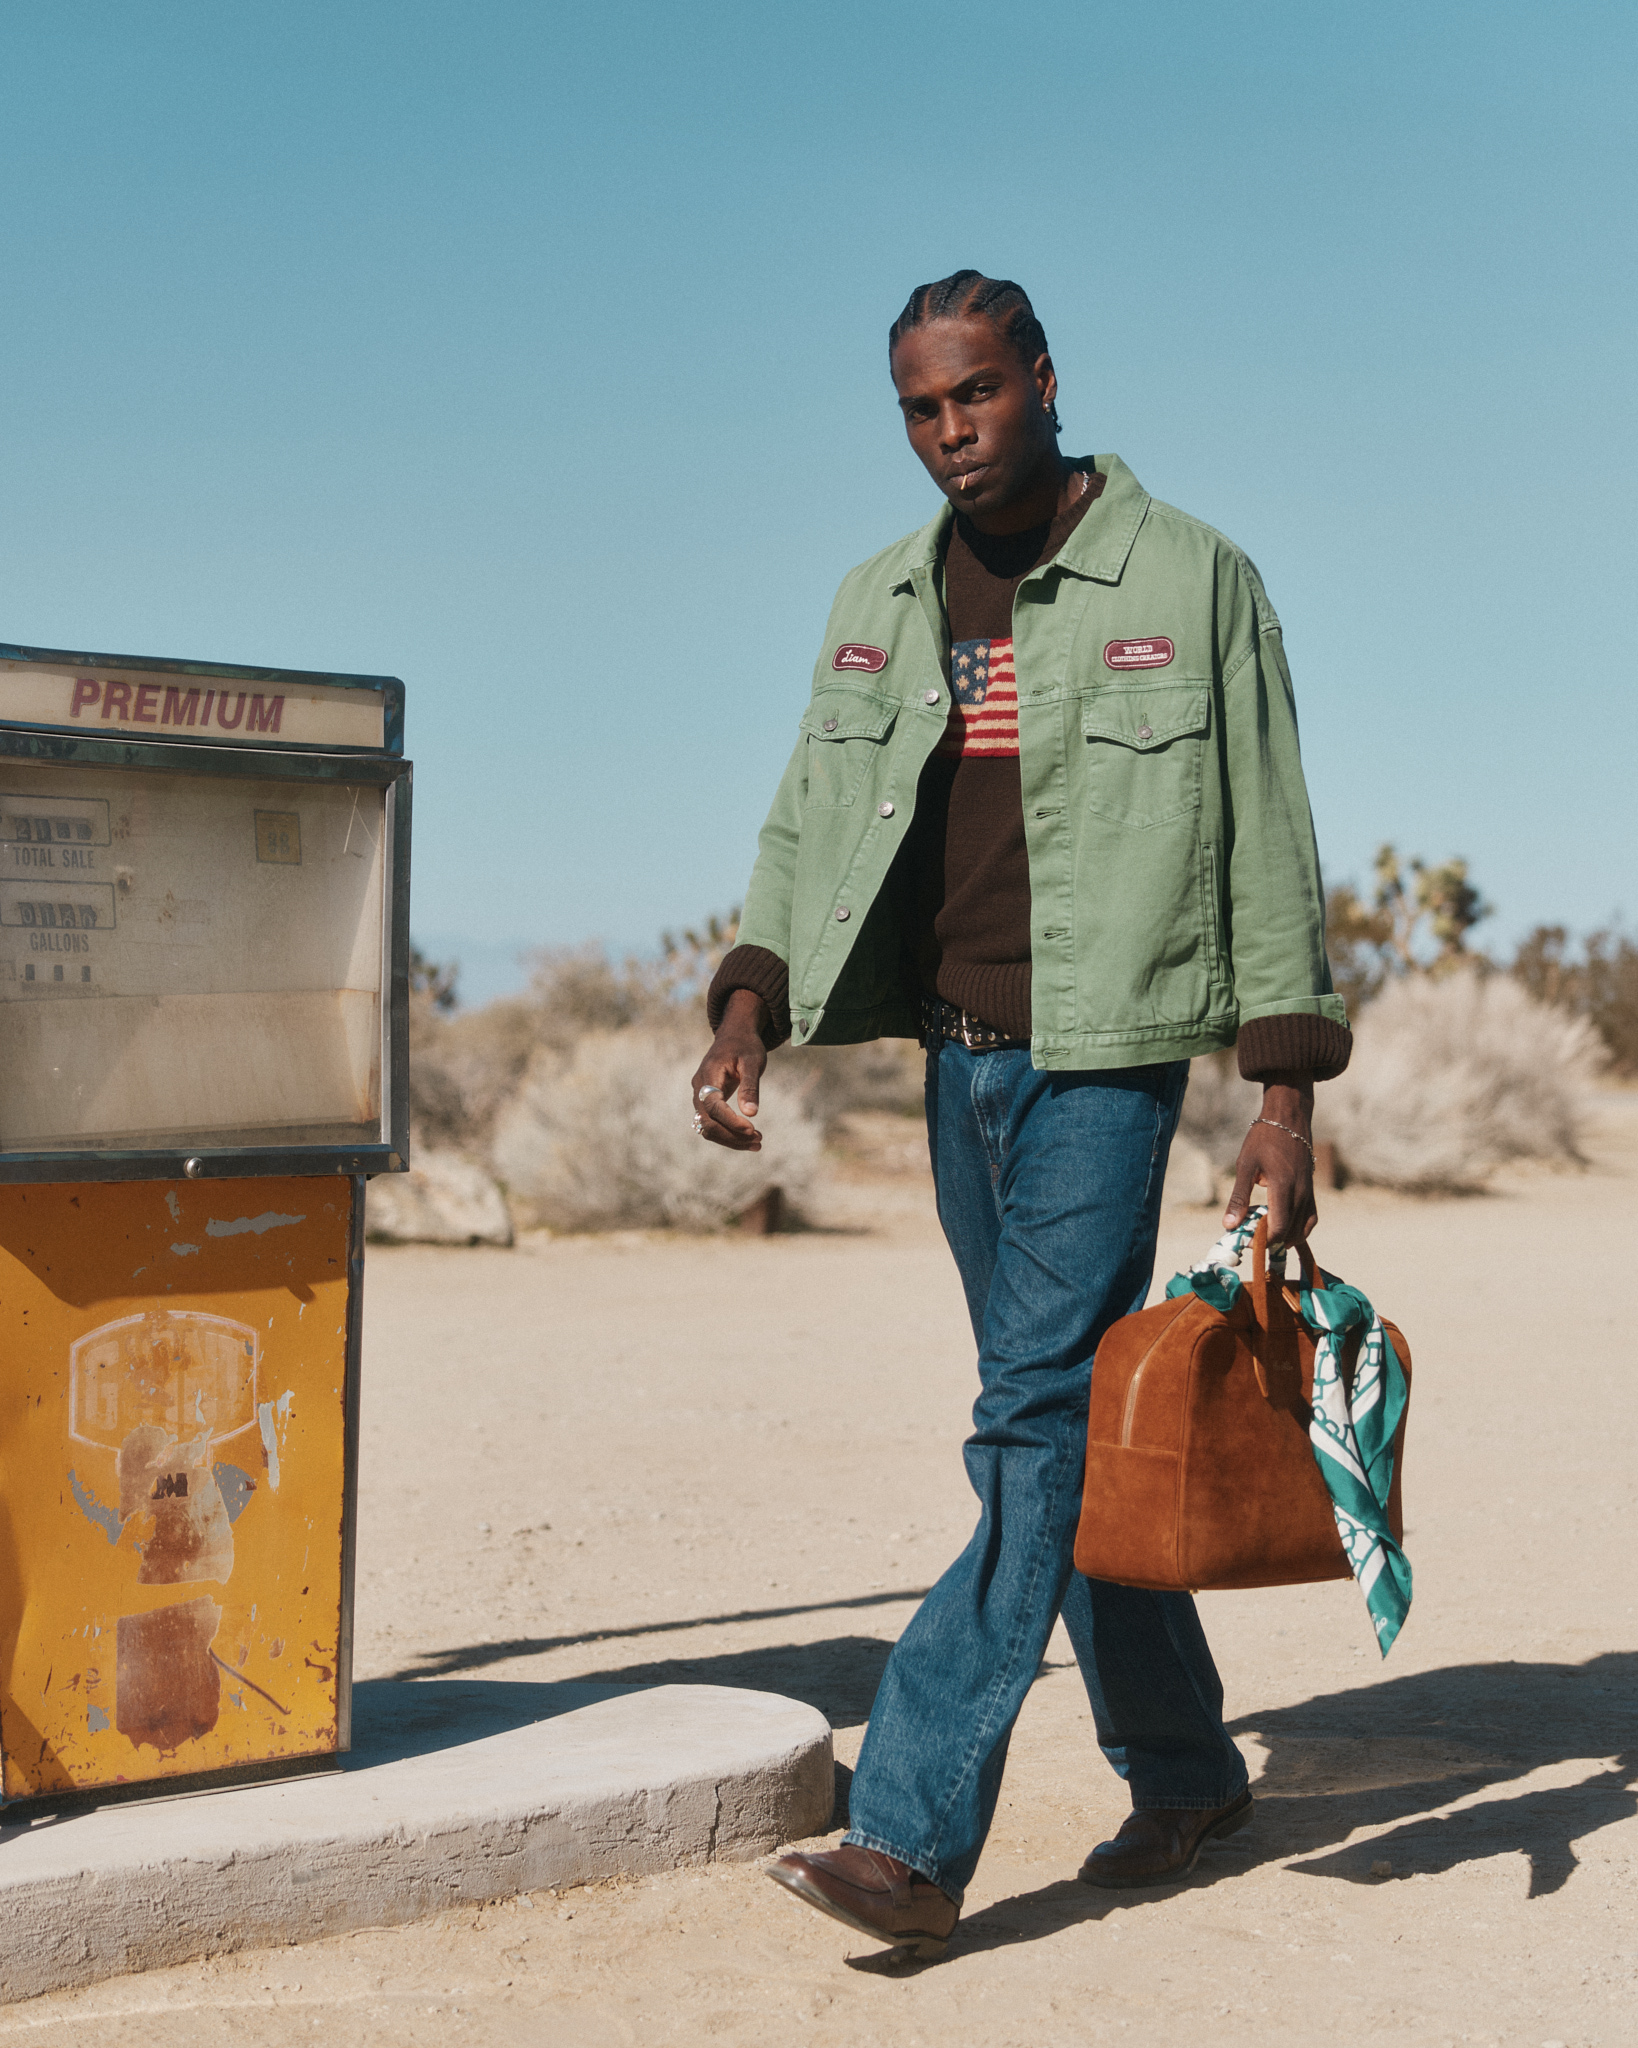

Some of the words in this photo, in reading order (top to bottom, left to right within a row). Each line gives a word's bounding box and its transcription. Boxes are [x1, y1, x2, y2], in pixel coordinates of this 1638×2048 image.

[1123, 645, 1153, 654] WORLD
[70, 678, 285, 734] PREMIUM
[13, 847, 55, 867] TOTAL
[62, 849, 95, 869] SALE
[30, 932, 90, 953] GALLONS
